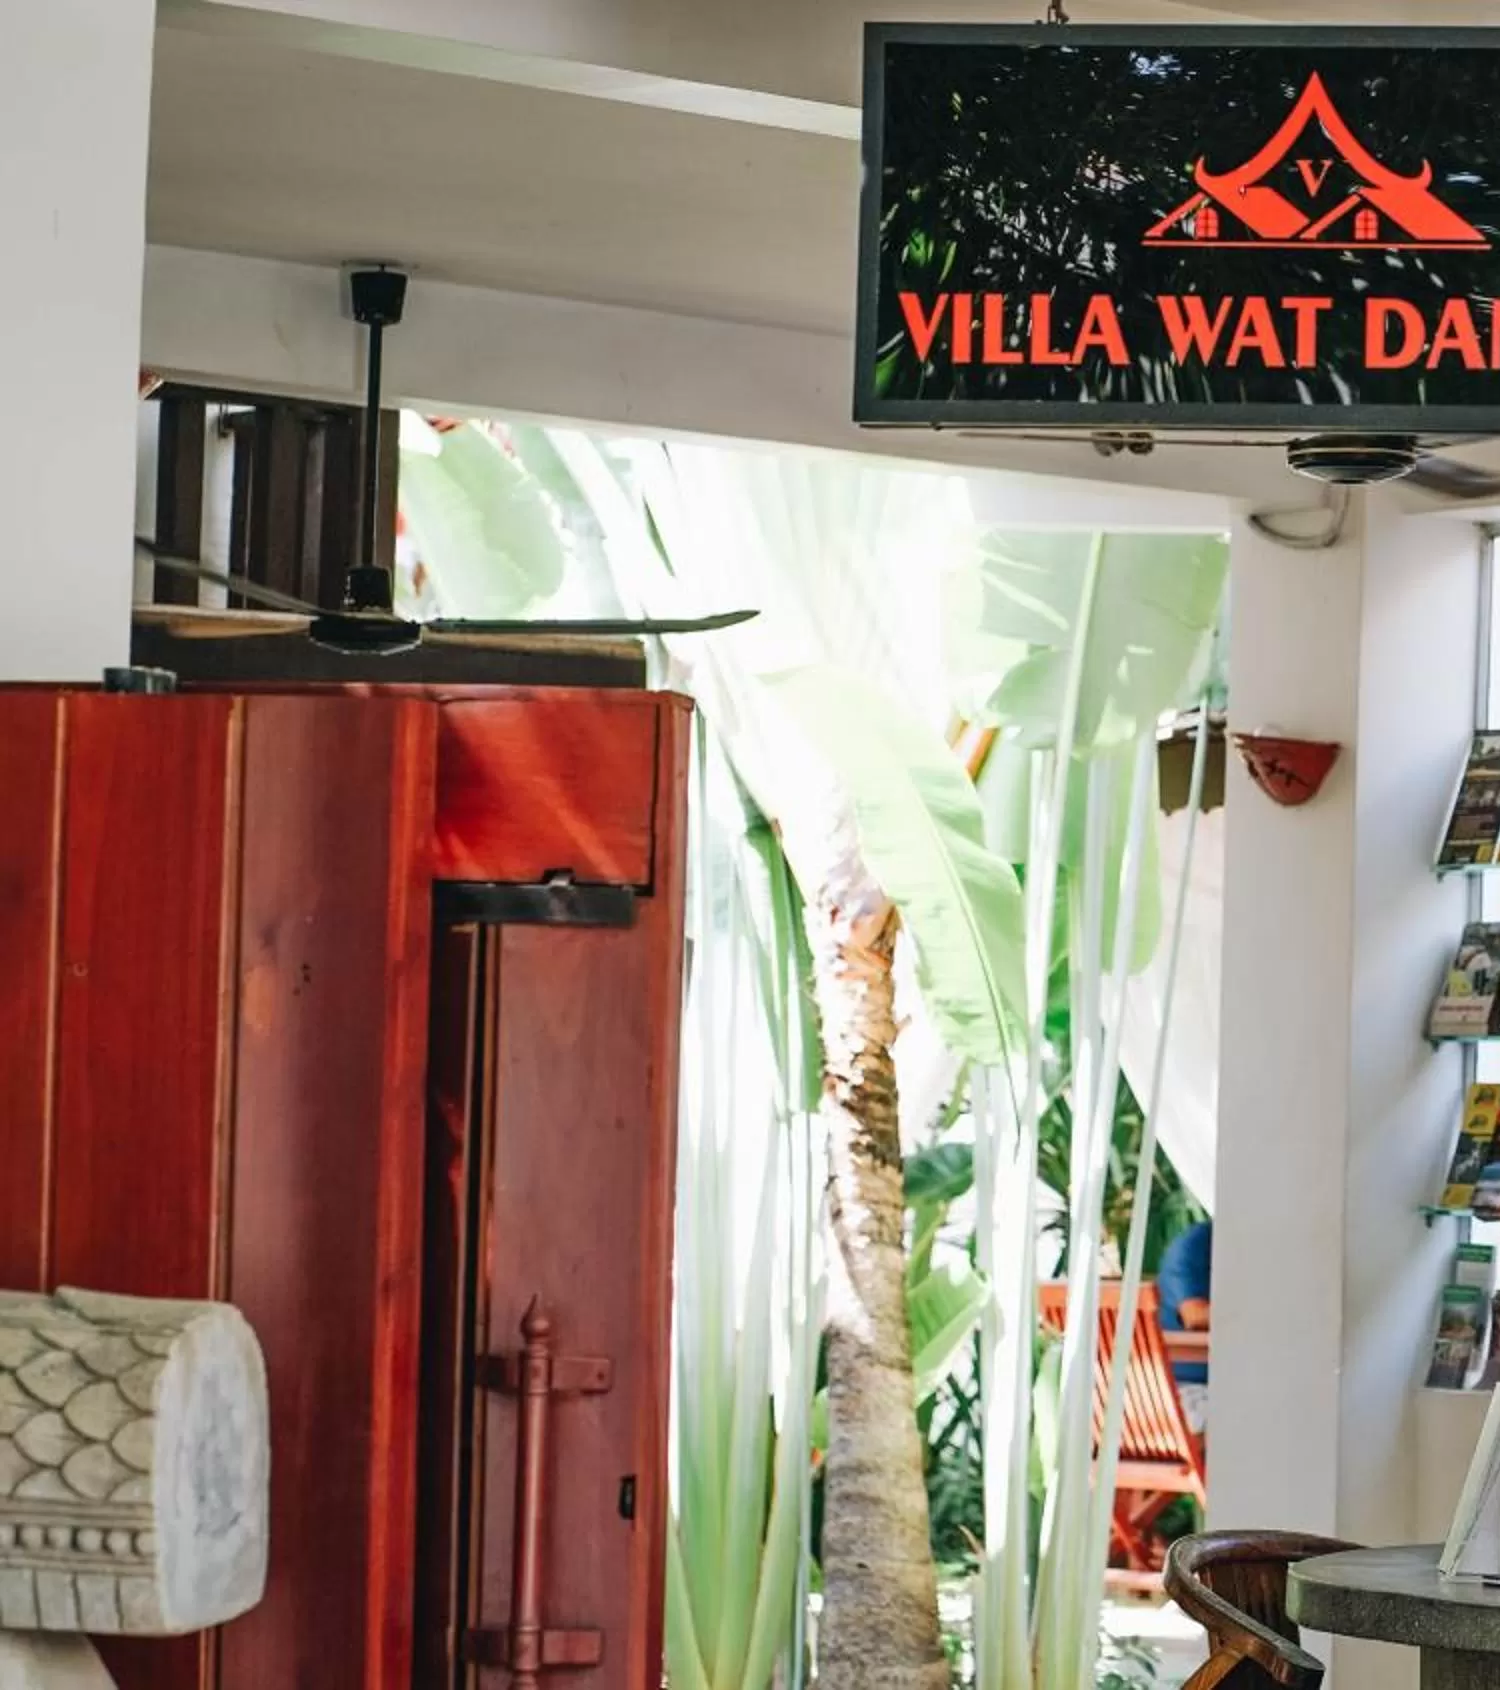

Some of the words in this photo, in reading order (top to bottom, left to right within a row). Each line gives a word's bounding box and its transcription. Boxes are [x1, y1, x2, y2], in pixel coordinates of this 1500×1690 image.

[1296, 159, 1334, 197] V
[899, 292, 1131, 366] VILLA
[1158, 296, 1332, 369] WAT
